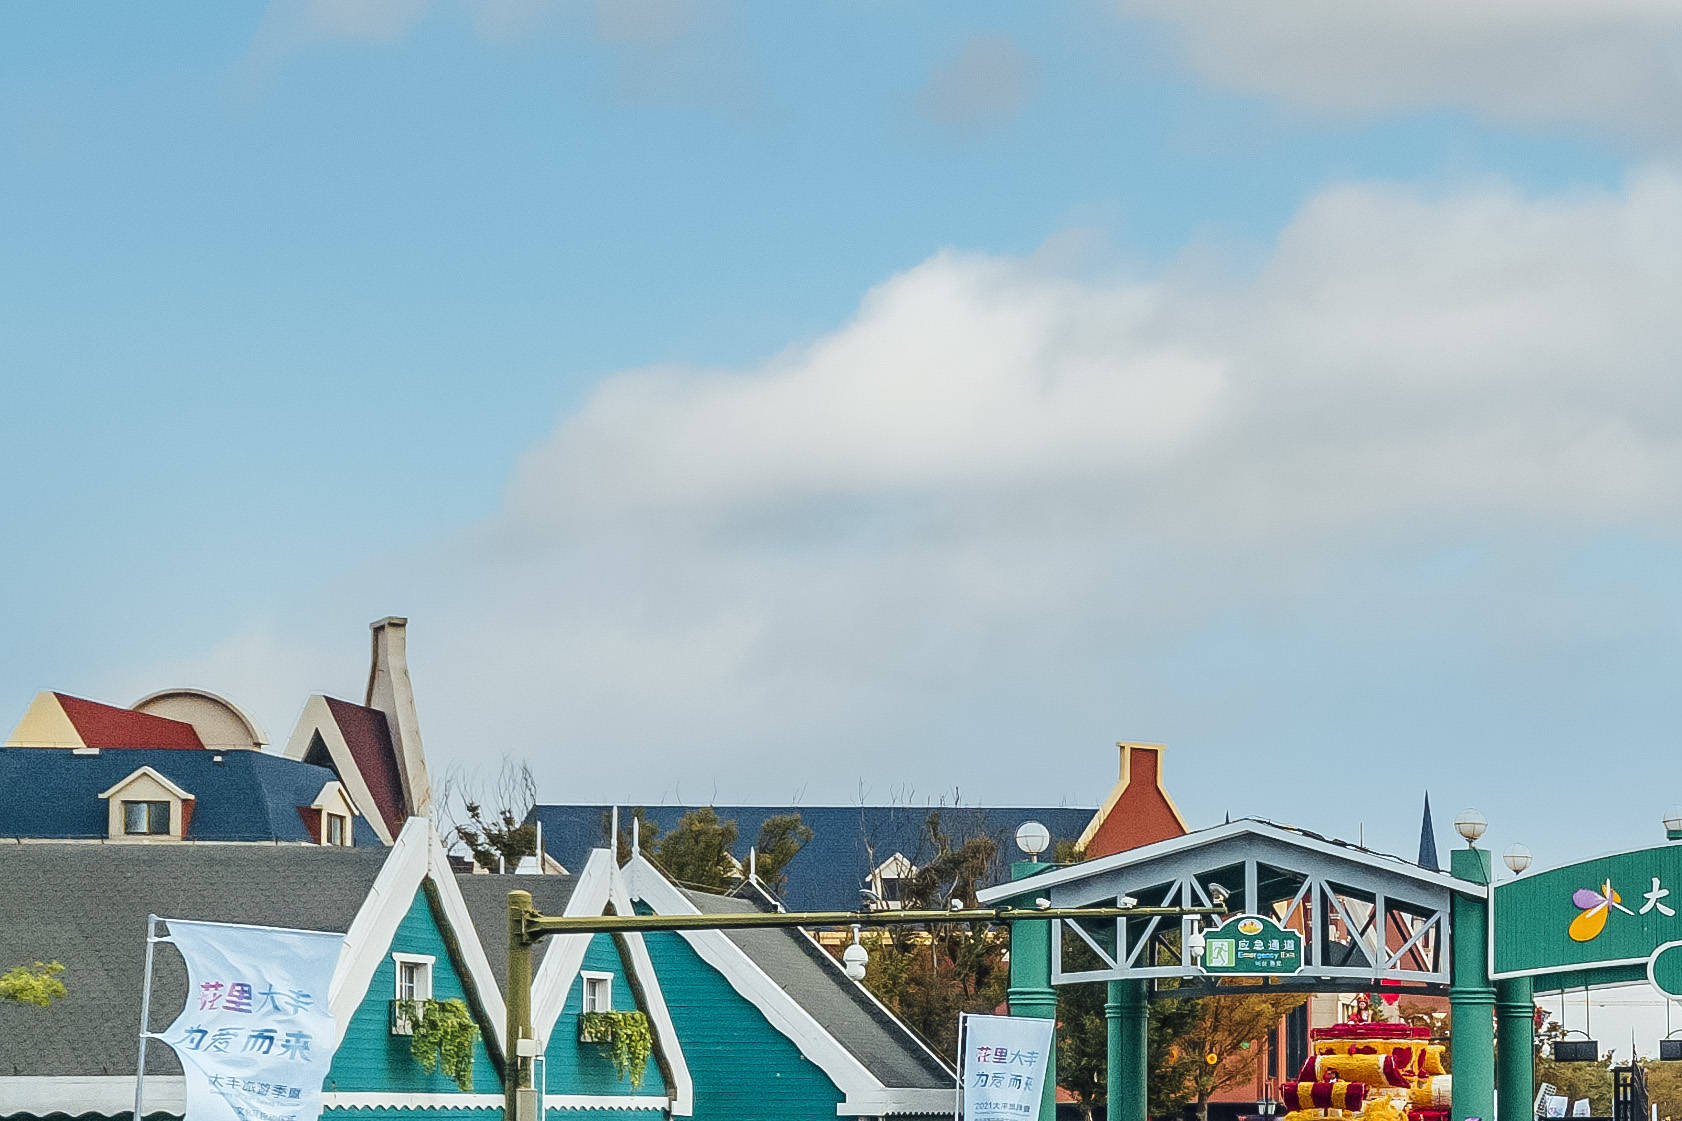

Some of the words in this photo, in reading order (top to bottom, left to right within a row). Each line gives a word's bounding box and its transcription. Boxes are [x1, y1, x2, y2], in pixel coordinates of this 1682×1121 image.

[1238, 939, 1295, 950] 应急通道
[198, 981, 313, 1015] 花里大丰
[173, 1024, 313, 1062] 为爱而来
[976, 1046, 1039, 1066] 花里大丰
